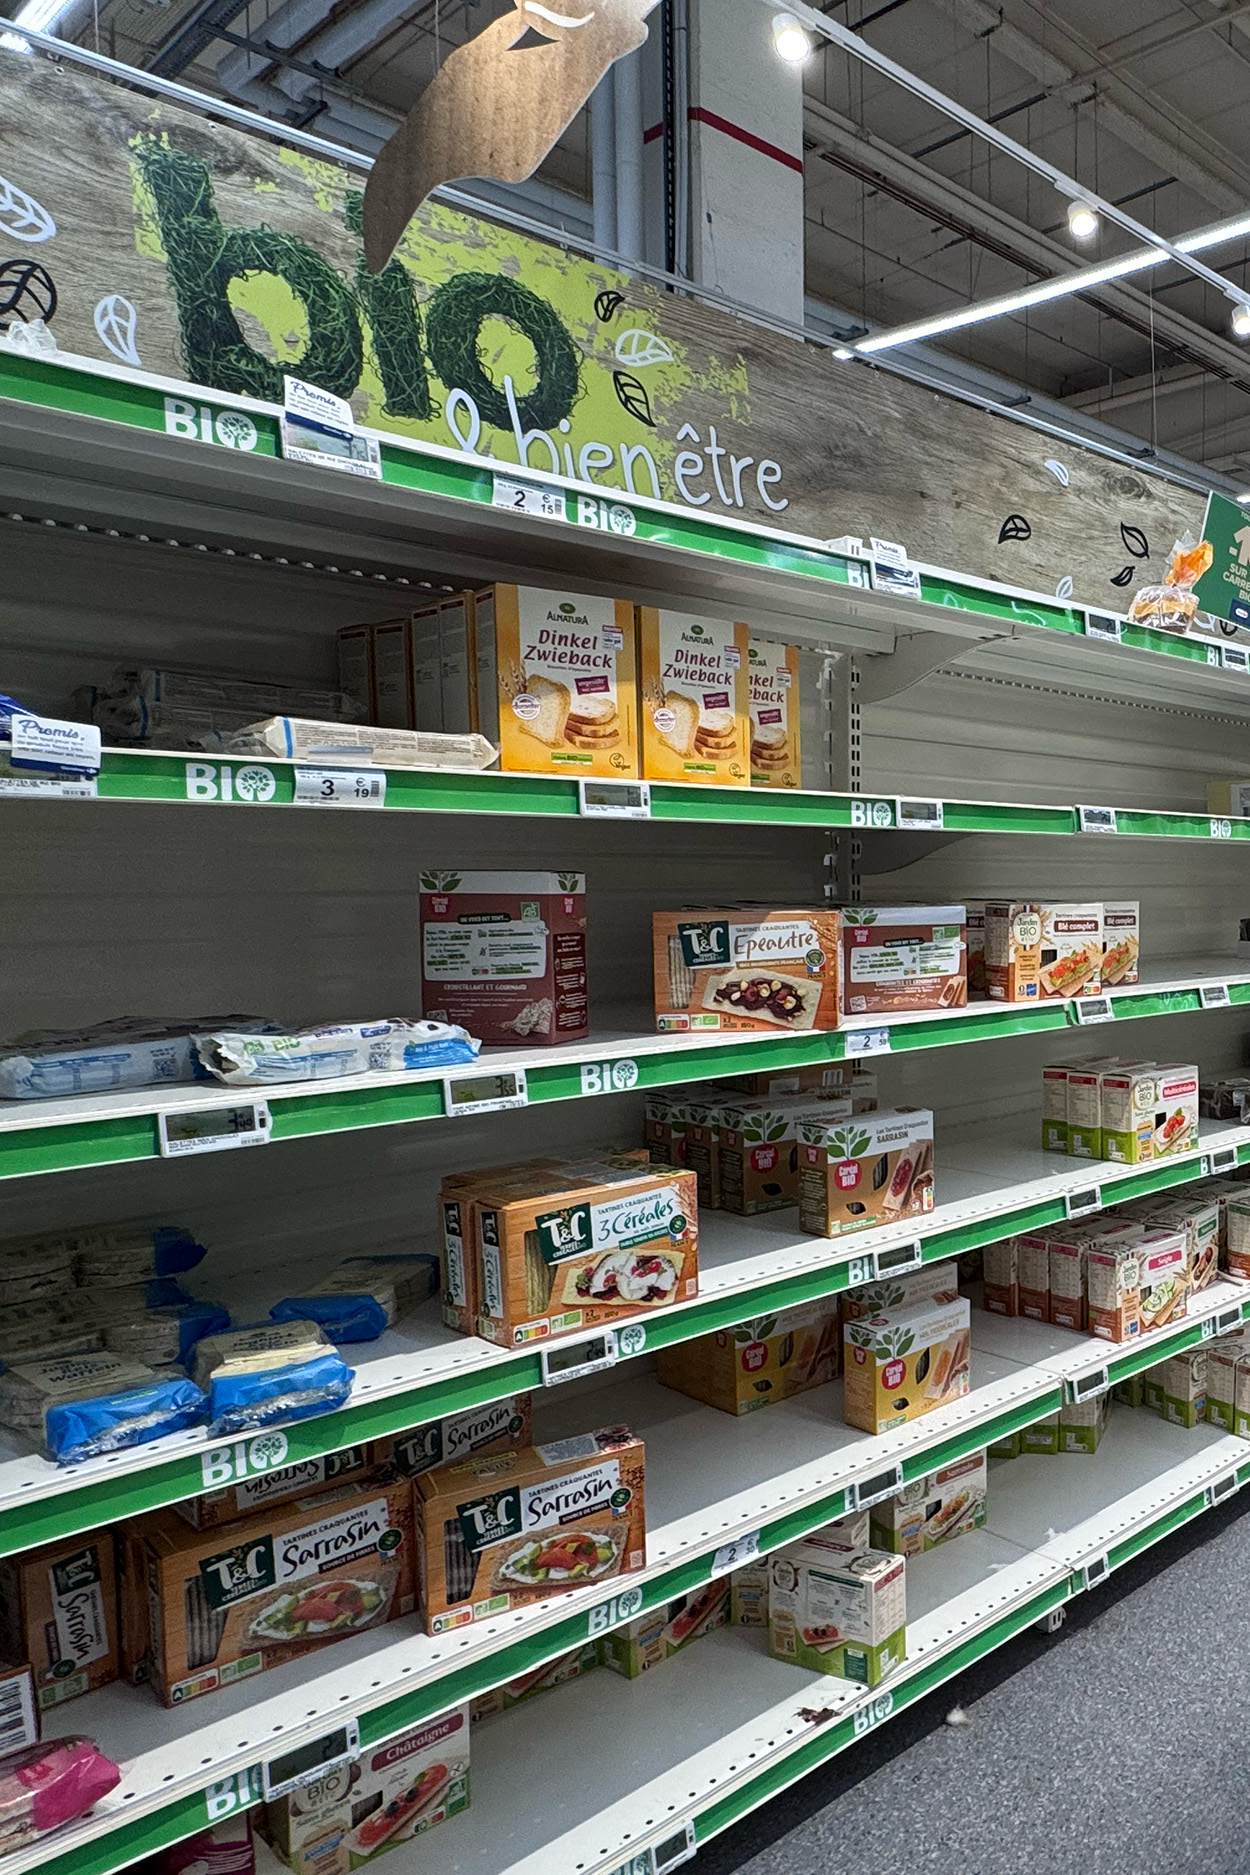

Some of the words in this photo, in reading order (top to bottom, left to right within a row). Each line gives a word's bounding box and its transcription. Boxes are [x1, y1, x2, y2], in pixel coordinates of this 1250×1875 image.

[136, 136, 583, 432] bio
[165, 397, 257, 451] BIO
[504, 375, 661, 500] bien
[674, 423, 788, 510] être
[515, 491, 525, 508] 2
[541, 504, 554, 514] 15
[577, 496, 636, 537] BIO
[1229, 564, 1247, 578] SUR
[539, 630, 598, 650] Dinkel
[524, 645, 613, 668] Zwieback
[674, 650, 721, 668] Dinkel
[663, 664, 732, 685] Zwieback
[19, 720, 85, 741] Promis.
[186, 762, 275, 801] BIO
[320, 779, 335, 796] 3
[353, 788, 369, 798] 19
[851, 801, 892, 826] BIO
[1210, 820, 1231, 837] BIO
[1017, 917, 1037, 926] Jardin
[1020, 926, 1036, 936] BIO
[1058, 922, 1068, 931] Blé
[1069, 922, 1095, 932] complet
[1115, 916, 1134, 925] complet
[682, 927, 724, 954] T&C
[734, 931, 813, 960] Epeautre
[864, 1036, 871, 1047] 2
[580, 1059, 638, 1094] BIO
[877, 1131, 908, 1143] SARRASIN
[842, 1175, 856, 1187] BIO
[598, 1204, 624, 1215] TARTINES
[625, 1193, 662, 1209] CRAQUANTES
[541, 1211, 586, 1248] T&C
[598, 1219, 610, 1242] 3
[612, 1198, 674, 1235] Céréales
[448, 1408, 510, 1455] Sarrasin
[200, 1431, 288, 1487] BIO
[528, 1484, 558, 1497] TARTINES
[559, 1469, 603, 1488] CRAQUANTES
[463, 1496, 514, 1534] T&C
[528, 1479, 612, 1526] Sarrasin
[563, 1512, 582, 1523] SOURCE
[591, 1502, 609, 1513] FIBRES
[283, 1530, 318, 1546] TARTINES
[319, 1509, 368, 1533] CRAQUANTES
[283, 1520, 380, 1577] Sarrasin
[728, 1548, 737, 1561] 2
[206, 1546, 266, 1590] T&C
[588, 1587, 642, 1635] BIO
[59, 1590, 89, 1661] Sarrasin
[854, 1691, 893, 1735] BIO
[386, 1722, 450, 1760] Châtaigne
[307, 1776, 341, 1799] BIO
